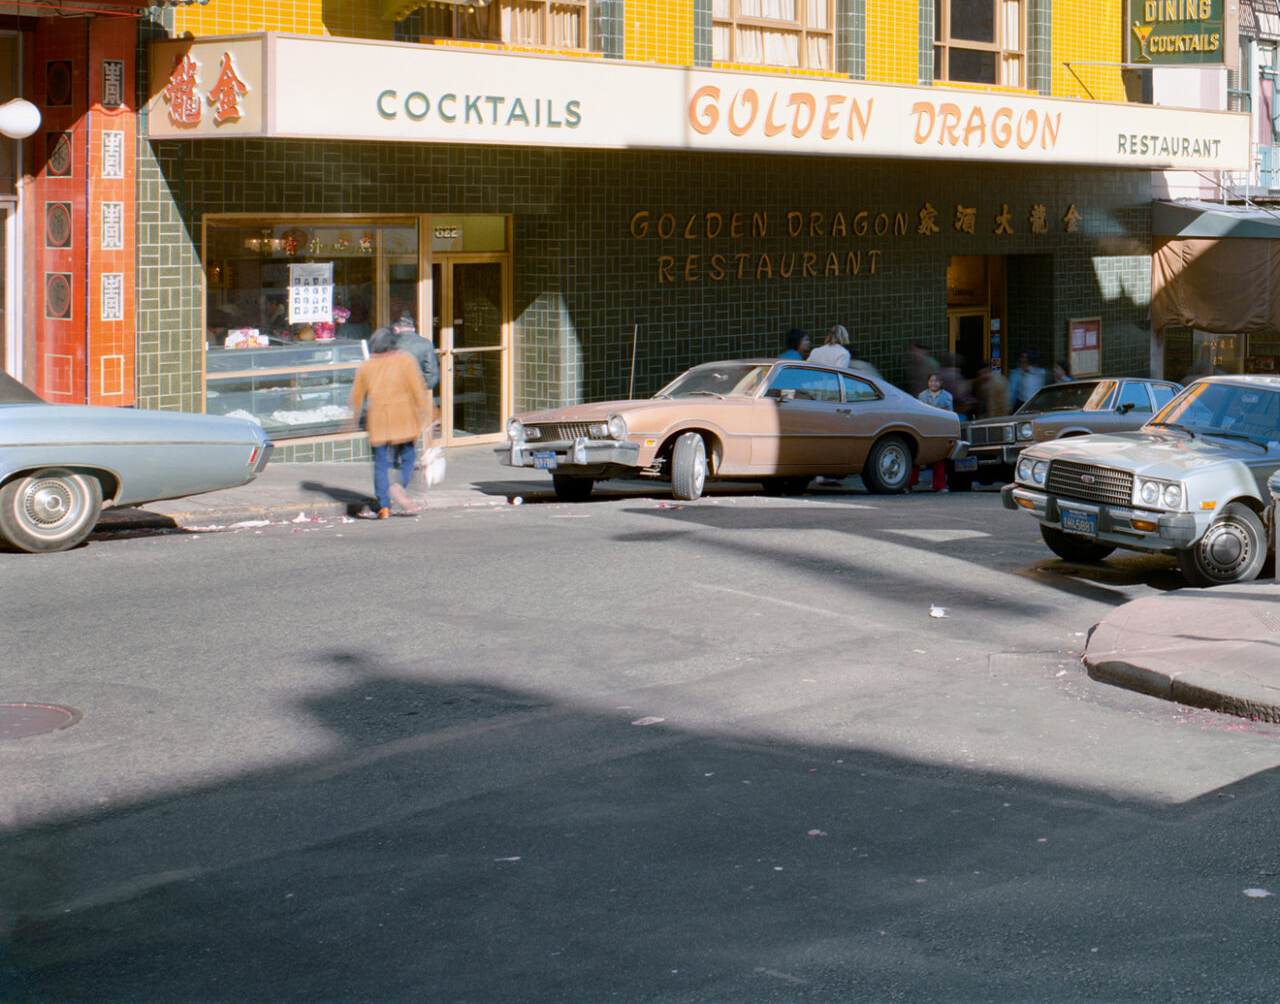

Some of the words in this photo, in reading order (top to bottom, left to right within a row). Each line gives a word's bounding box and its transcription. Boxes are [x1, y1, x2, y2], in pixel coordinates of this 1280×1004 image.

[1150, 34, 1219, 53] COCKTAILS
[376, 89, 582, 129] COCKTAILS
[689, 85, 874, 142] GOLDEN
[909, 100, 1062, 150] DRAGON
[1117, 133, 1221, 158] RESTAURANT
[630, 210, 768, 239] GOLDEN
[788, 210, 909, 238] DRAGON
[657, 249, 882, 284] RESTAURANT
